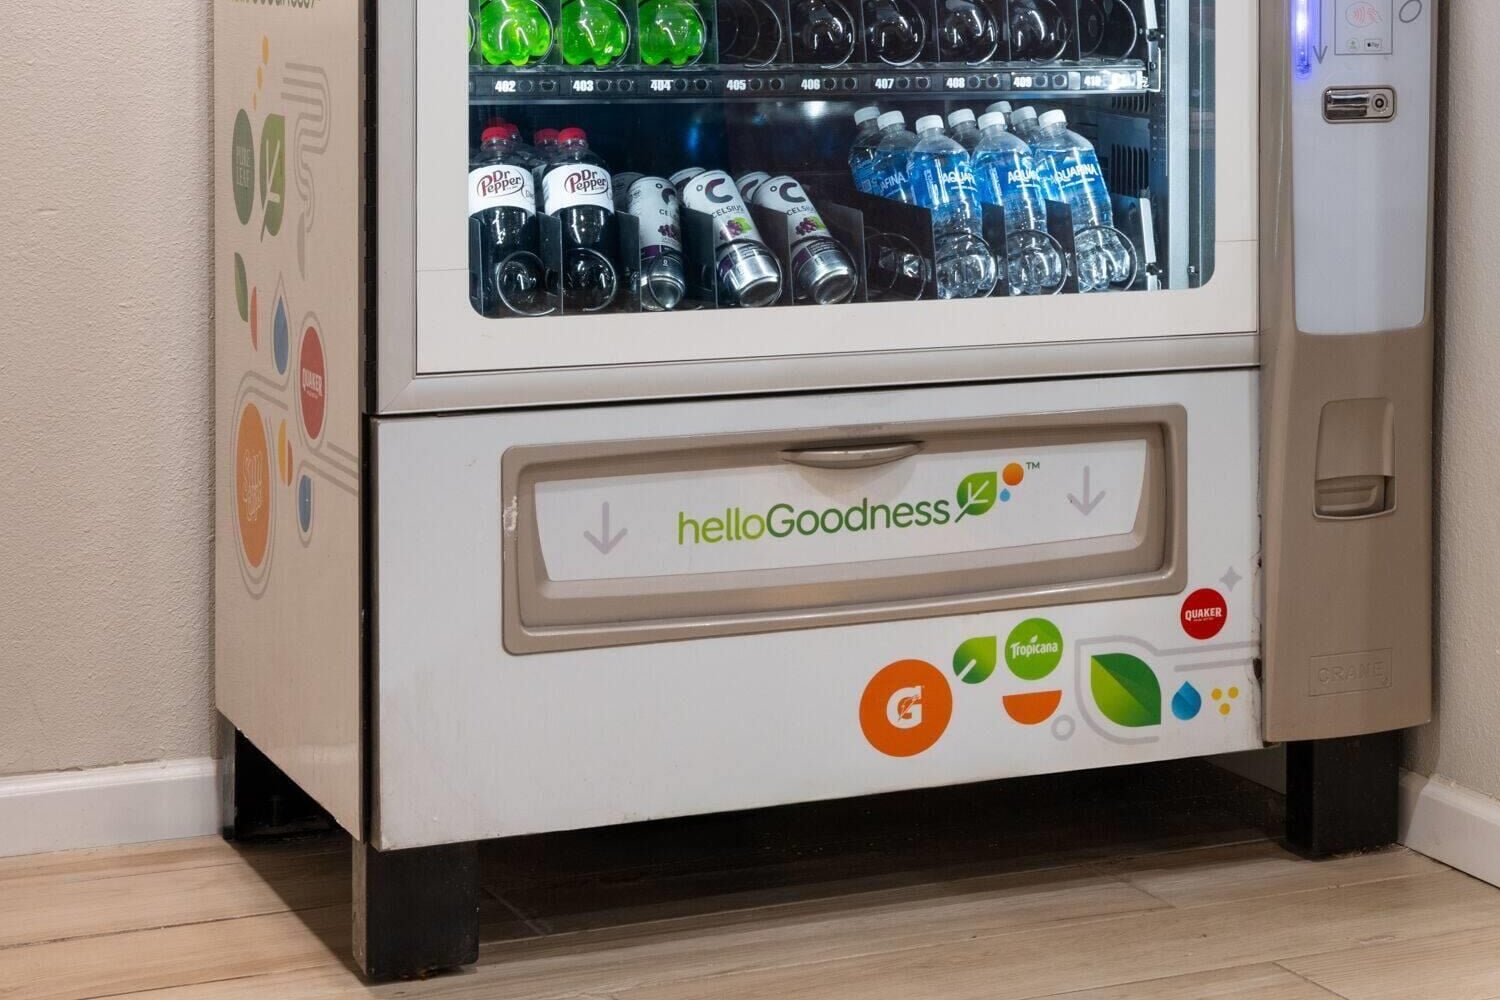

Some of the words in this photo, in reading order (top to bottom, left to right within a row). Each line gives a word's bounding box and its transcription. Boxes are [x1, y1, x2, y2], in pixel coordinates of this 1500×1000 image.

[573, 80, 594, 92] 403
[651, 80, 671, 91] 404
[726, 79, 746, 90] 405
[801, 78, 820, 90] 406
[875, 77, 894, 89] 407
[946, 77, 965, 89] 408
[1013, 77, 1032, 88] 409
[493, 169, 511, 182] Dr
[580, 169, 598, 181] Dr
[480, 174, 521, 197] Pepper
[570, 172, 606, 194] Pepper
[302, 368, 324, 396] QUAKER
[679, 498, 950, 545] helloGoodness
[1185, 607, 1222, 621] QUAKER
[1010, 641, 1059, 659] Tropicana
[1318, 661, 1385, 685] CRANE
[886, 685, 922, 729] G
